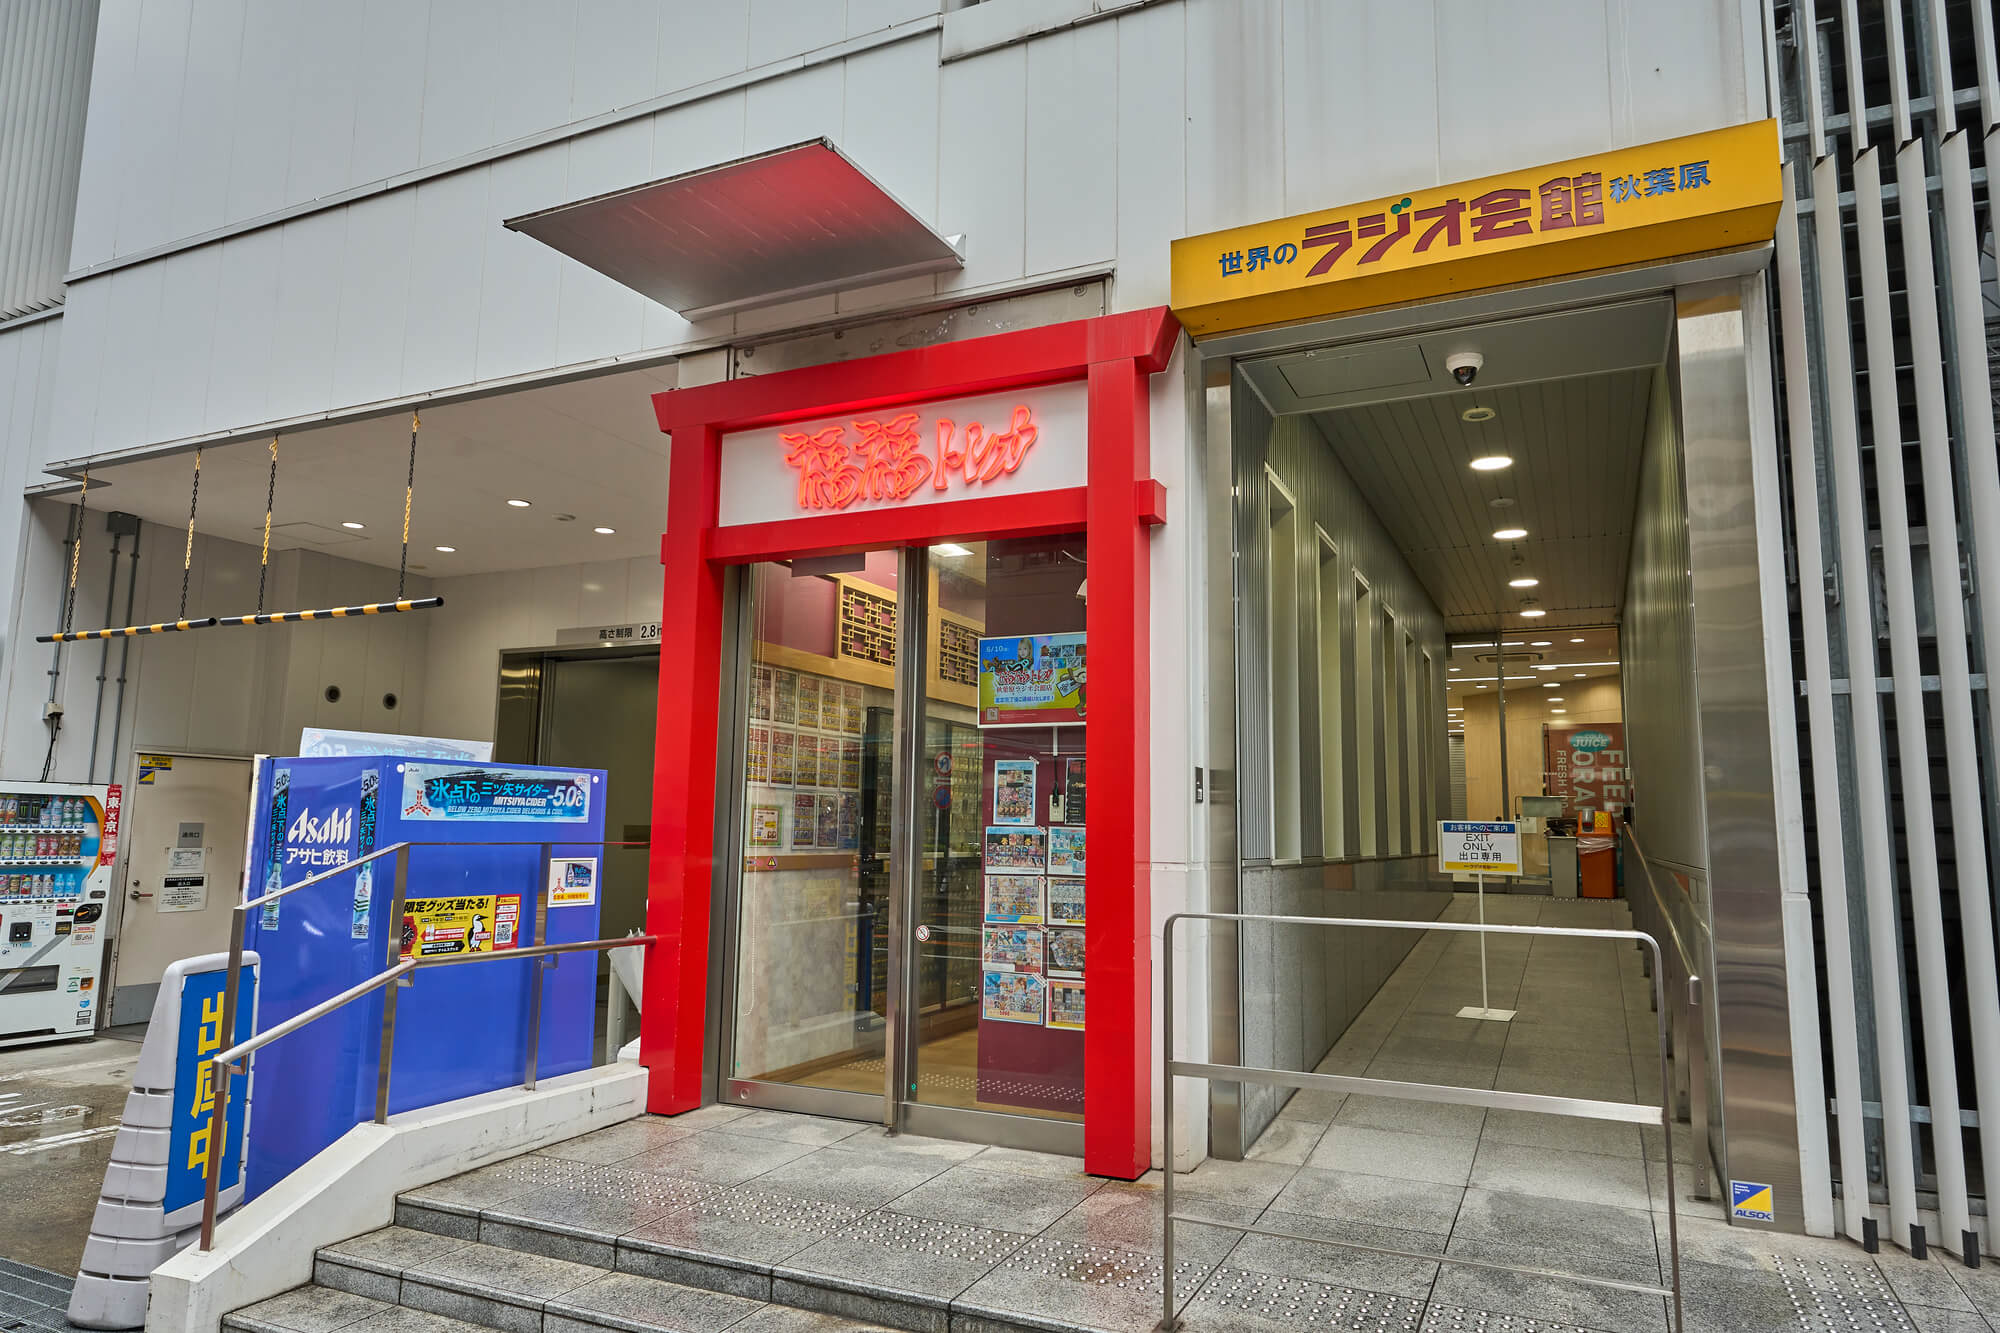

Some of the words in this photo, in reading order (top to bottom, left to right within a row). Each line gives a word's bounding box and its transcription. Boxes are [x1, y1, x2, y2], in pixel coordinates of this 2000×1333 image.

[1219, 243, 1297, 278] 世界の
[1302, 172, 1605, 278] ラジオ会館
[1609, 160, 1711, 204] 秋葉原
[599, 627, 633, 640] 高さ制限
[1573, 738, 1608, 748] JUICE
[1557, 750, 1568, 787] FRESH
[287, 807, 353, 845] Asahi
[1450, 824, 1508, 832] お客様へのご案内
[1465, 833, 1490, 842] EXIT
[1462, 842, 1494, 851] ONLY
[286, 847, 349, 866] アサヒ飲料
[1459, 851, 1502, 862] 出口専用
[1735, 1209, 1772, 1220] ALSOK
